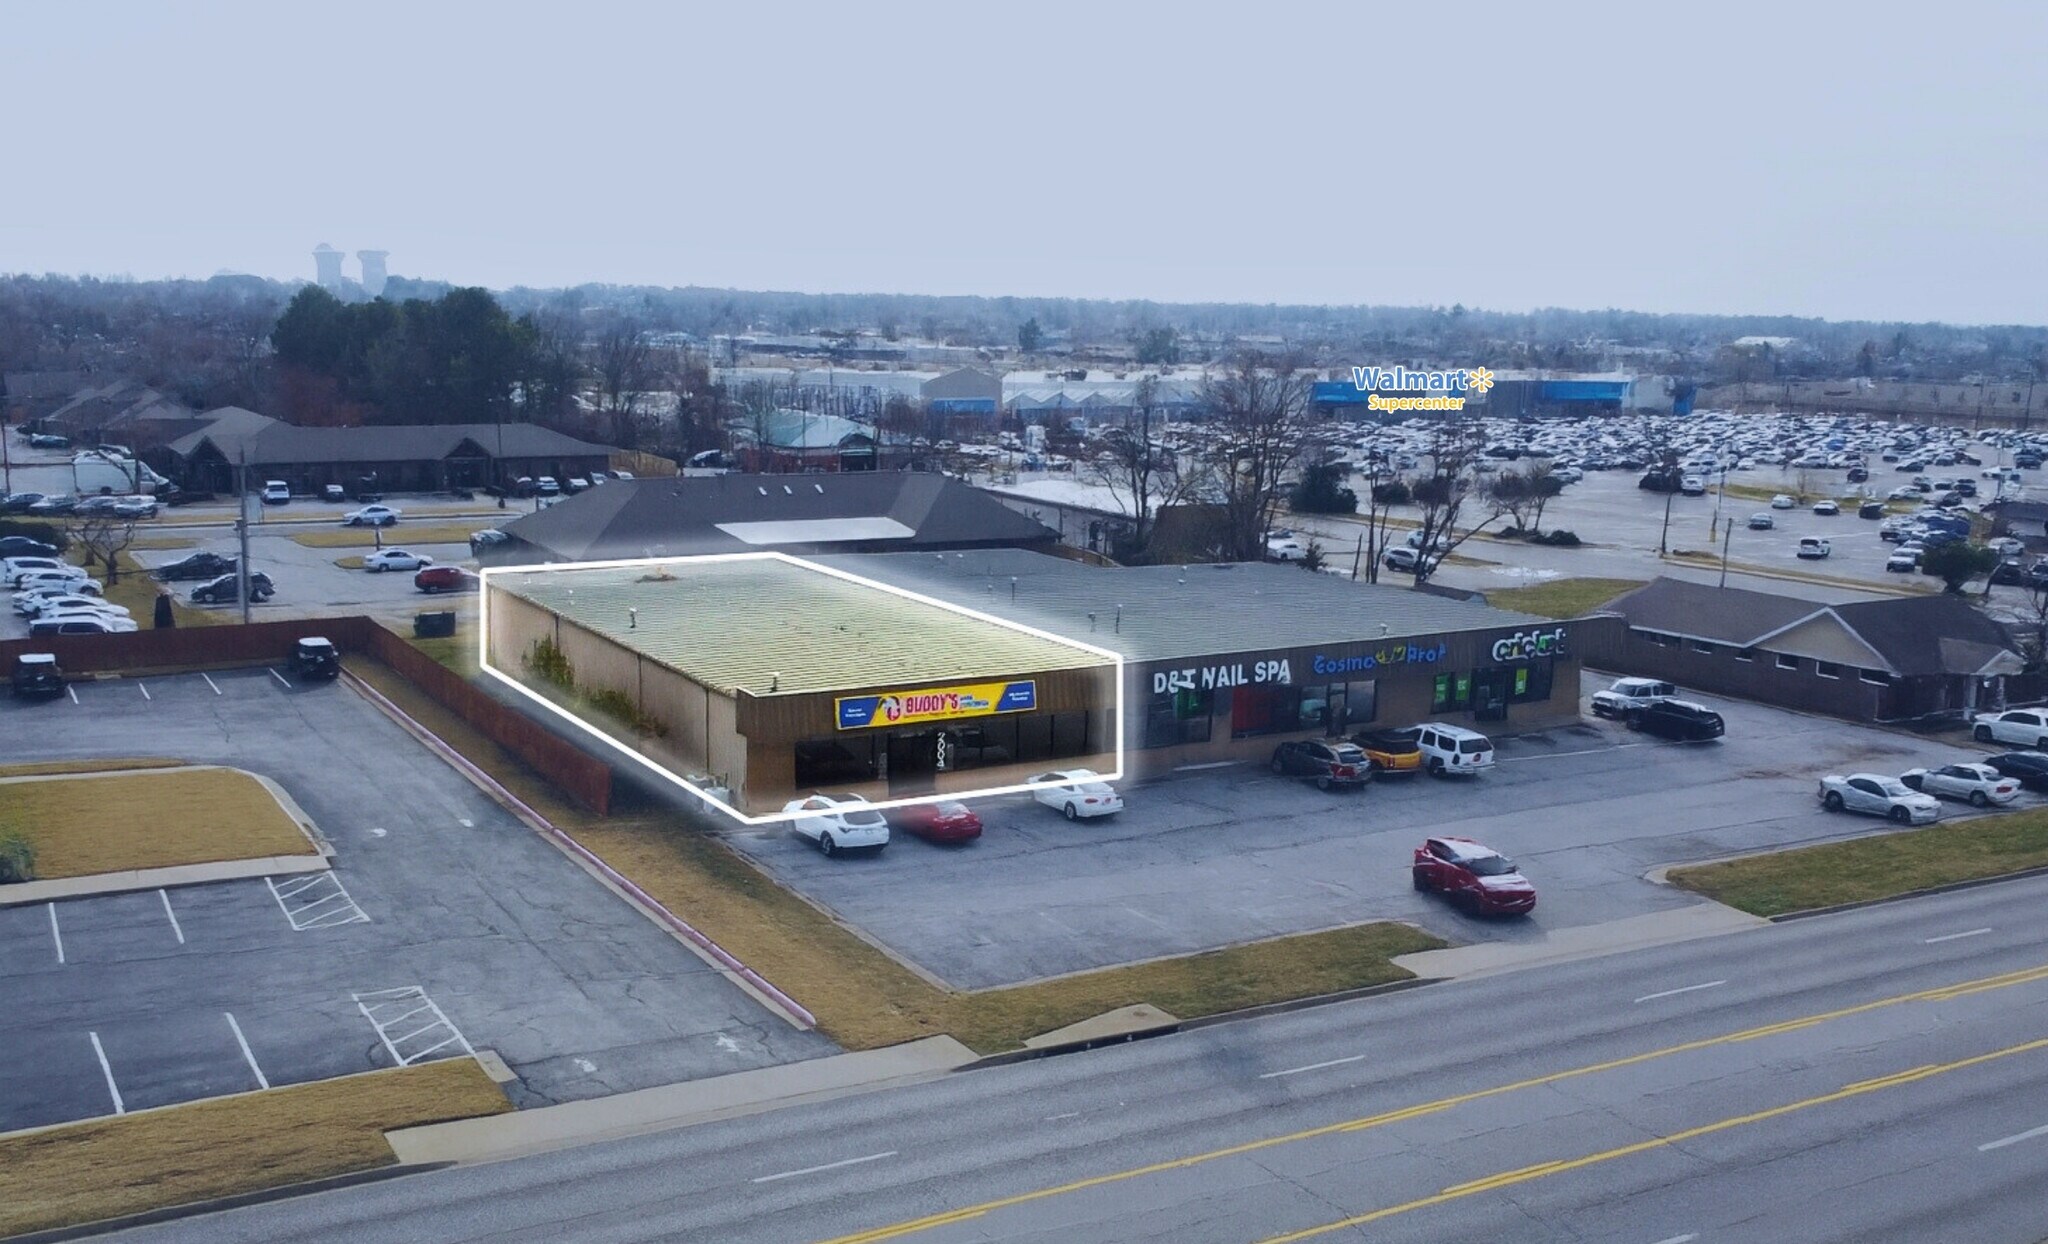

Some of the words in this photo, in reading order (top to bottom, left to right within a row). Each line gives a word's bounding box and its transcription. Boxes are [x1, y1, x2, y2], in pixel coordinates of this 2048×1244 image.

[1154, 668, 1196, 694] D&T
[1202, 664, 1248, 689] NAIL
[1254, 659, 1292, 684] SPA
[906, 693, 958, 714] BUDDY'S
